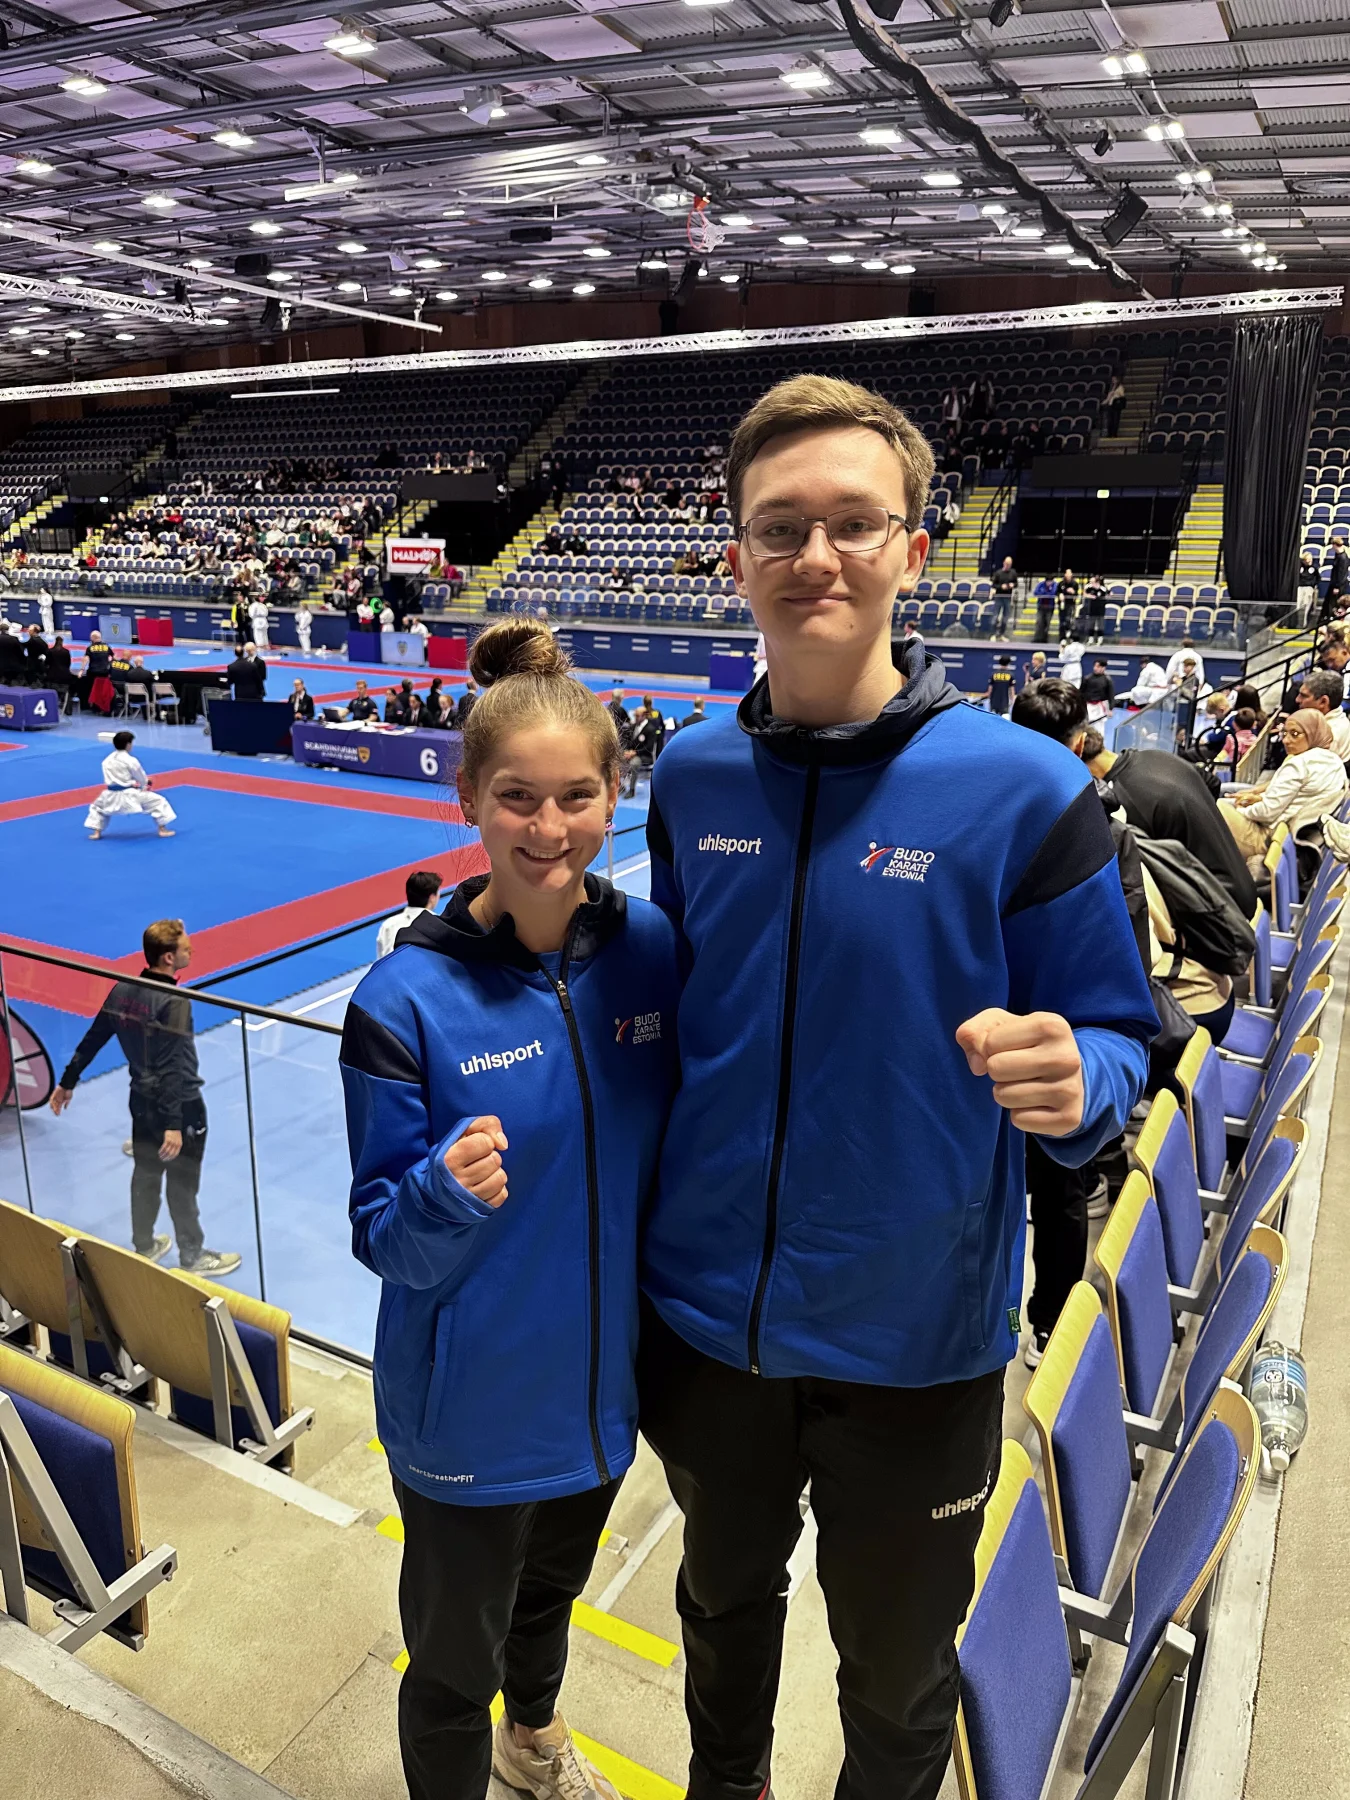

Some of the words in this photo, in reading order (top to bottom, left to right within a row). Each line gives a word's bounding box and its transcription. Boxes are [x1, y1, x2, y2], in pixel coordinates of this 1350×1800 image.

[33, 699, 48, 717] 4
[419, 747, 439, 776] 6
[698, 833, 762, 856] uhlsport
[893, 847, 935, 864] BUDO
[888, 859, 930, 873] KARATE
[881, 867, 925, 883] ESTONIA
[634, 1011, 661, 1027] BUDO
[634, 1023, 661, 1036] KARATE
[632, 1031, 662, 1045] ESTONIA
[460, 1039, 544, 1076] uhlsport
